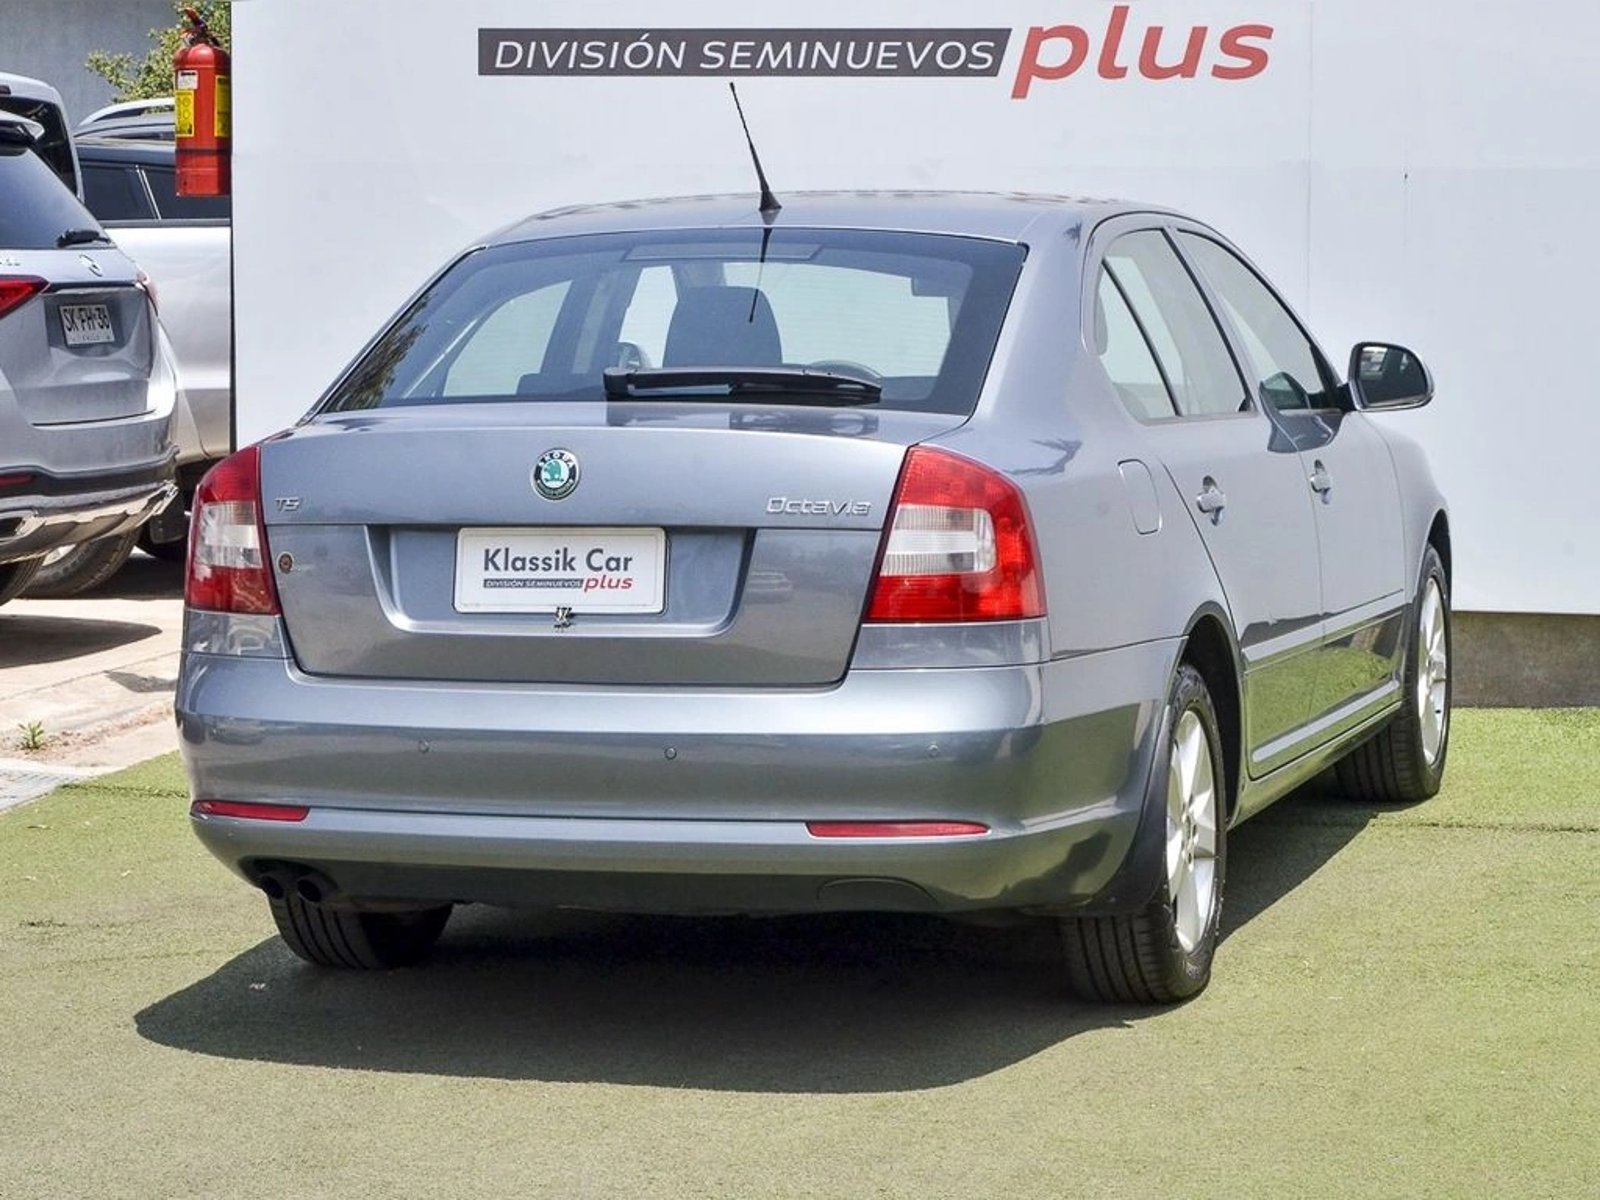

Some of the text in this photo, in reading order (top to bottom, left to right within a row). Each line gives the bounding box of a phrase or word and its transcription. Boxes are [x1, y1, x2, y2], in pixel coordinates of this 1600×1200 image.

[494, 5, 1274, 99] DIVISIÓN SEMINUEVOS plus
[766, 497, 871, 516] Octavia
[484, 547, 633, 572] Klassik Car
[584, 575, 633, 592] plus
